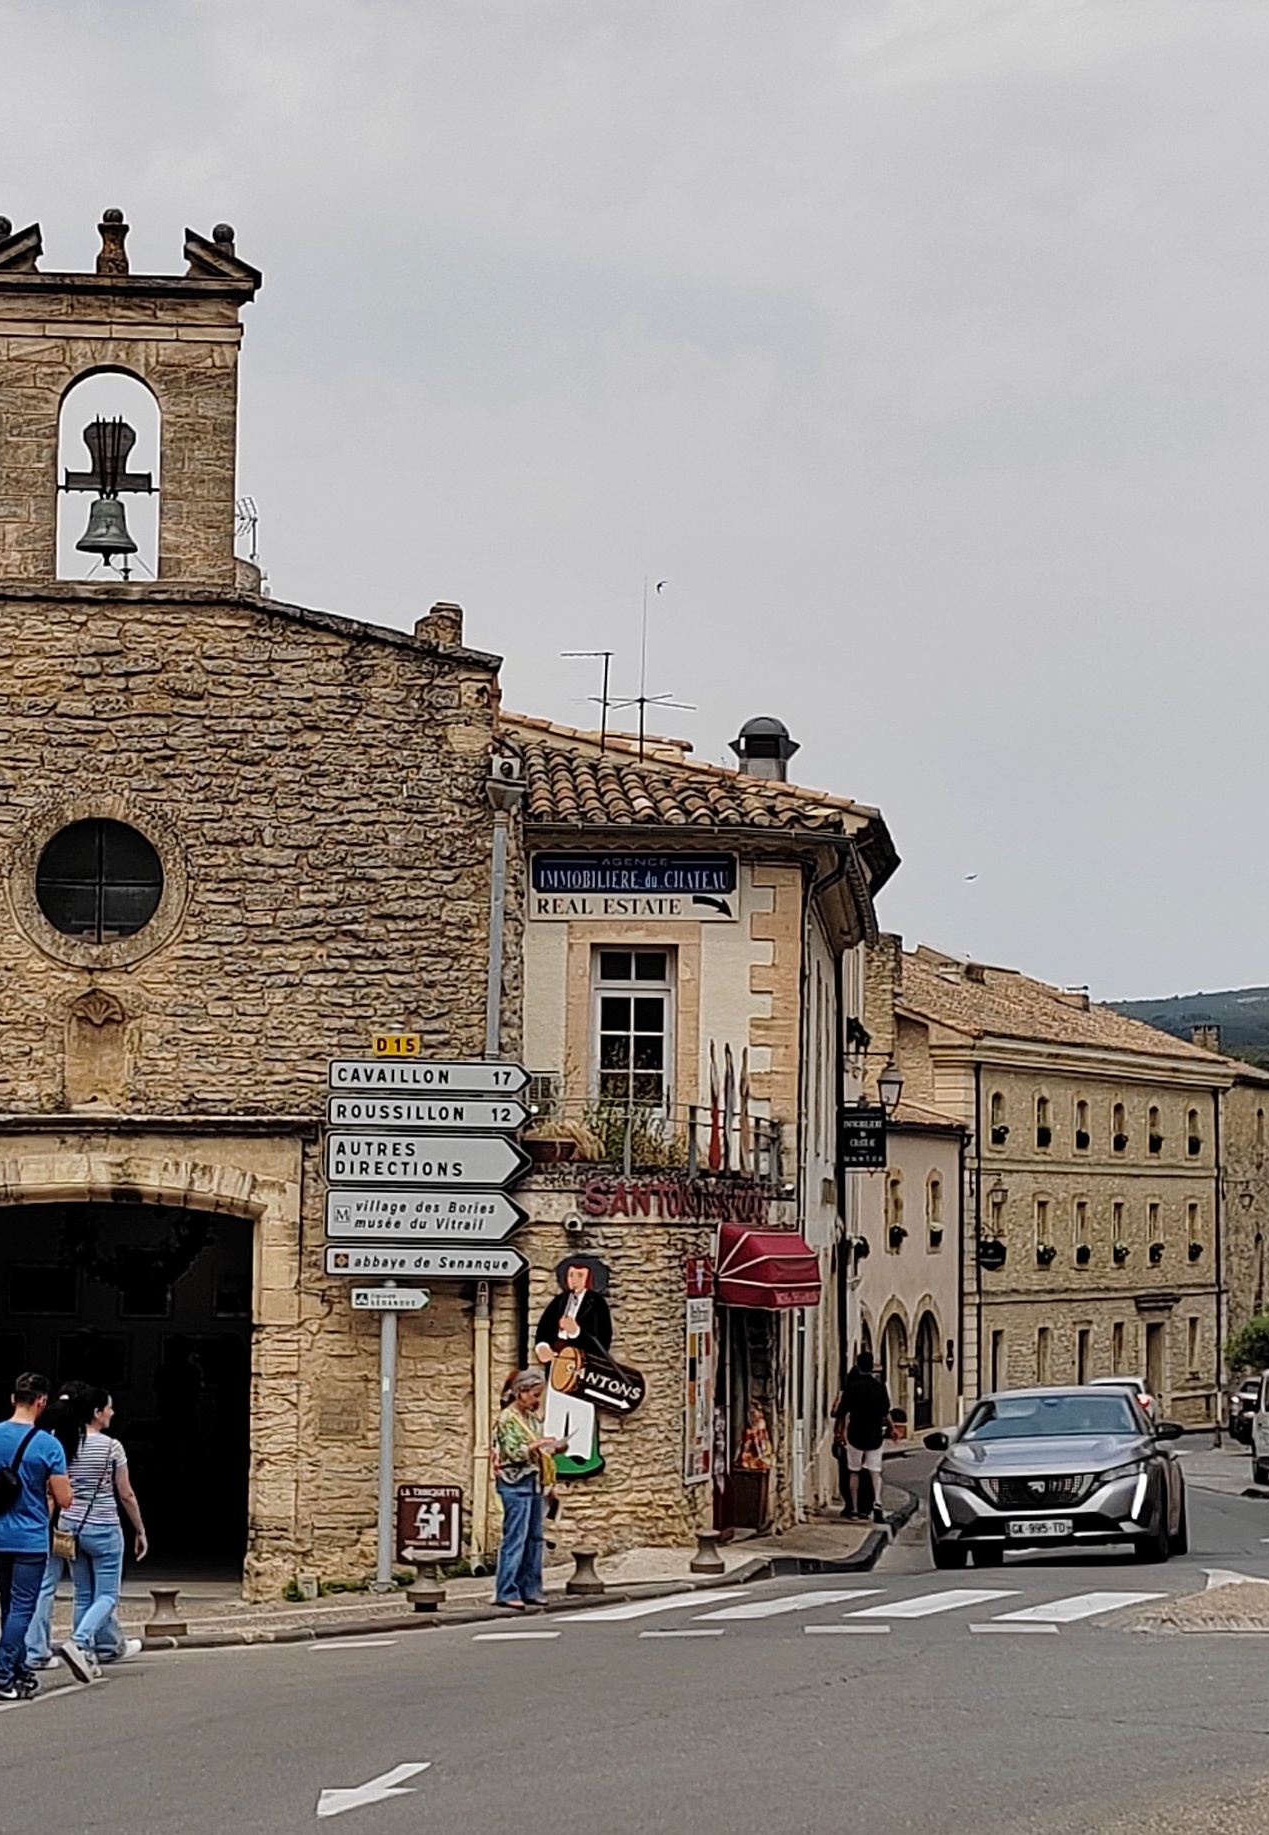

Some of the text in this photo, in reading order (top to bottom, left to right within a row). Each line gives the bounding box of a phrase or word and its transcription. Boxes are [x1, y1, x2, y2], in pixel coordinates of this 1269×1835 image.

[601, 858, 669, 867] AGENCE
[540, 870, 638, 889] IMMOBILIERE
[645, 870, 658, 889] du
[537, 898, 682, 915] REAL ESTATE
[376, 1038, 416, 1052] D 15
[337, 1068, 512, 1086] CAVAILLON 17
[336, 1104, 512, 1122] ROUSSILLON 12
[336, 1141, 416, 1156] AUTRES
[334, 1161, 463, 1177] DIRECTIONS
[355, 1200, 496, 1214] village des Bories
[354, 1216, 483, 1231] musée du Vitrail
[354, 1256, 509, 1272] abbaye de Senanque
